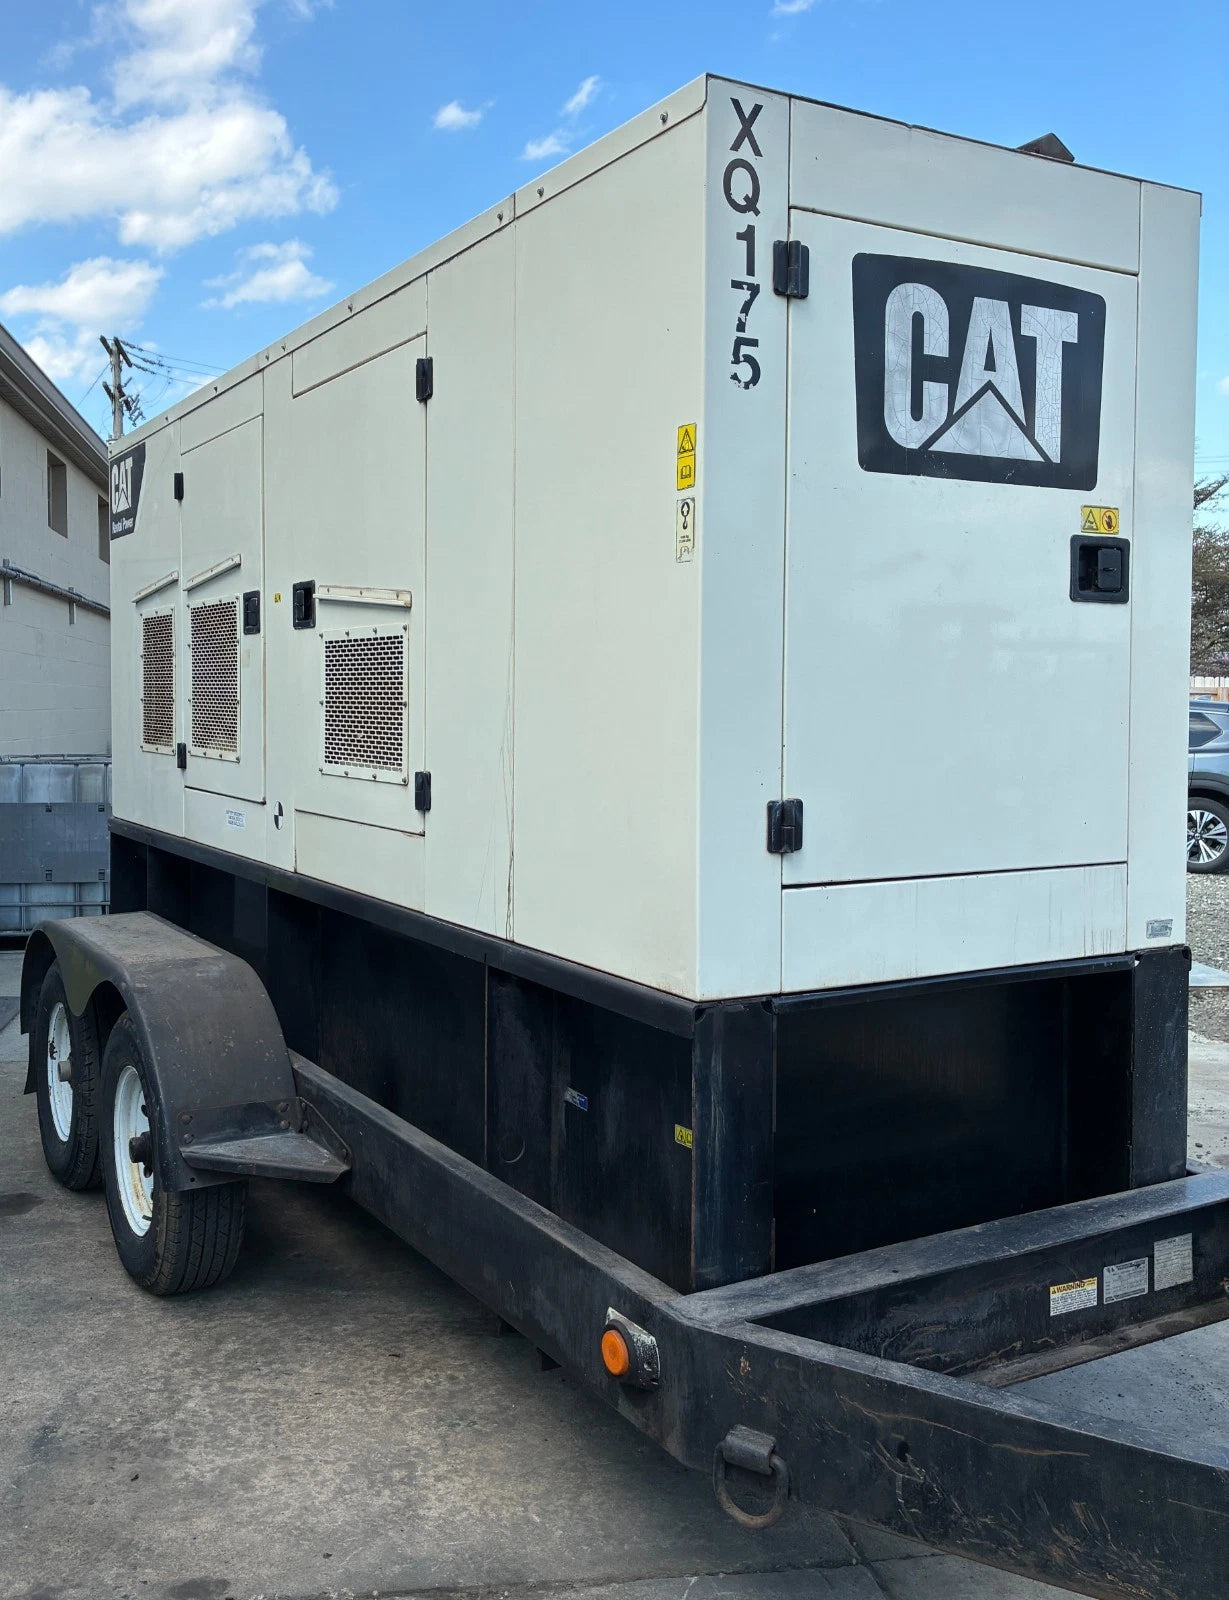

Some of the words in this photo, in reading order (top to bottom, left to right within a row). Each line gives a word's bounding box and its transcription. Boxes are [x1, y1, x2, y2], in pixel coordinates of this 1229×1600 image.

[723, 97, 764, 389] XQ175
[884, 282, 1079, 464] CAT
[112, 457, 133, 514] CAT
[112, 519, 123, 534] Rental
[123, 517, 134, 530] Power
[1056, 1281, 1085, 1293] WARNING
